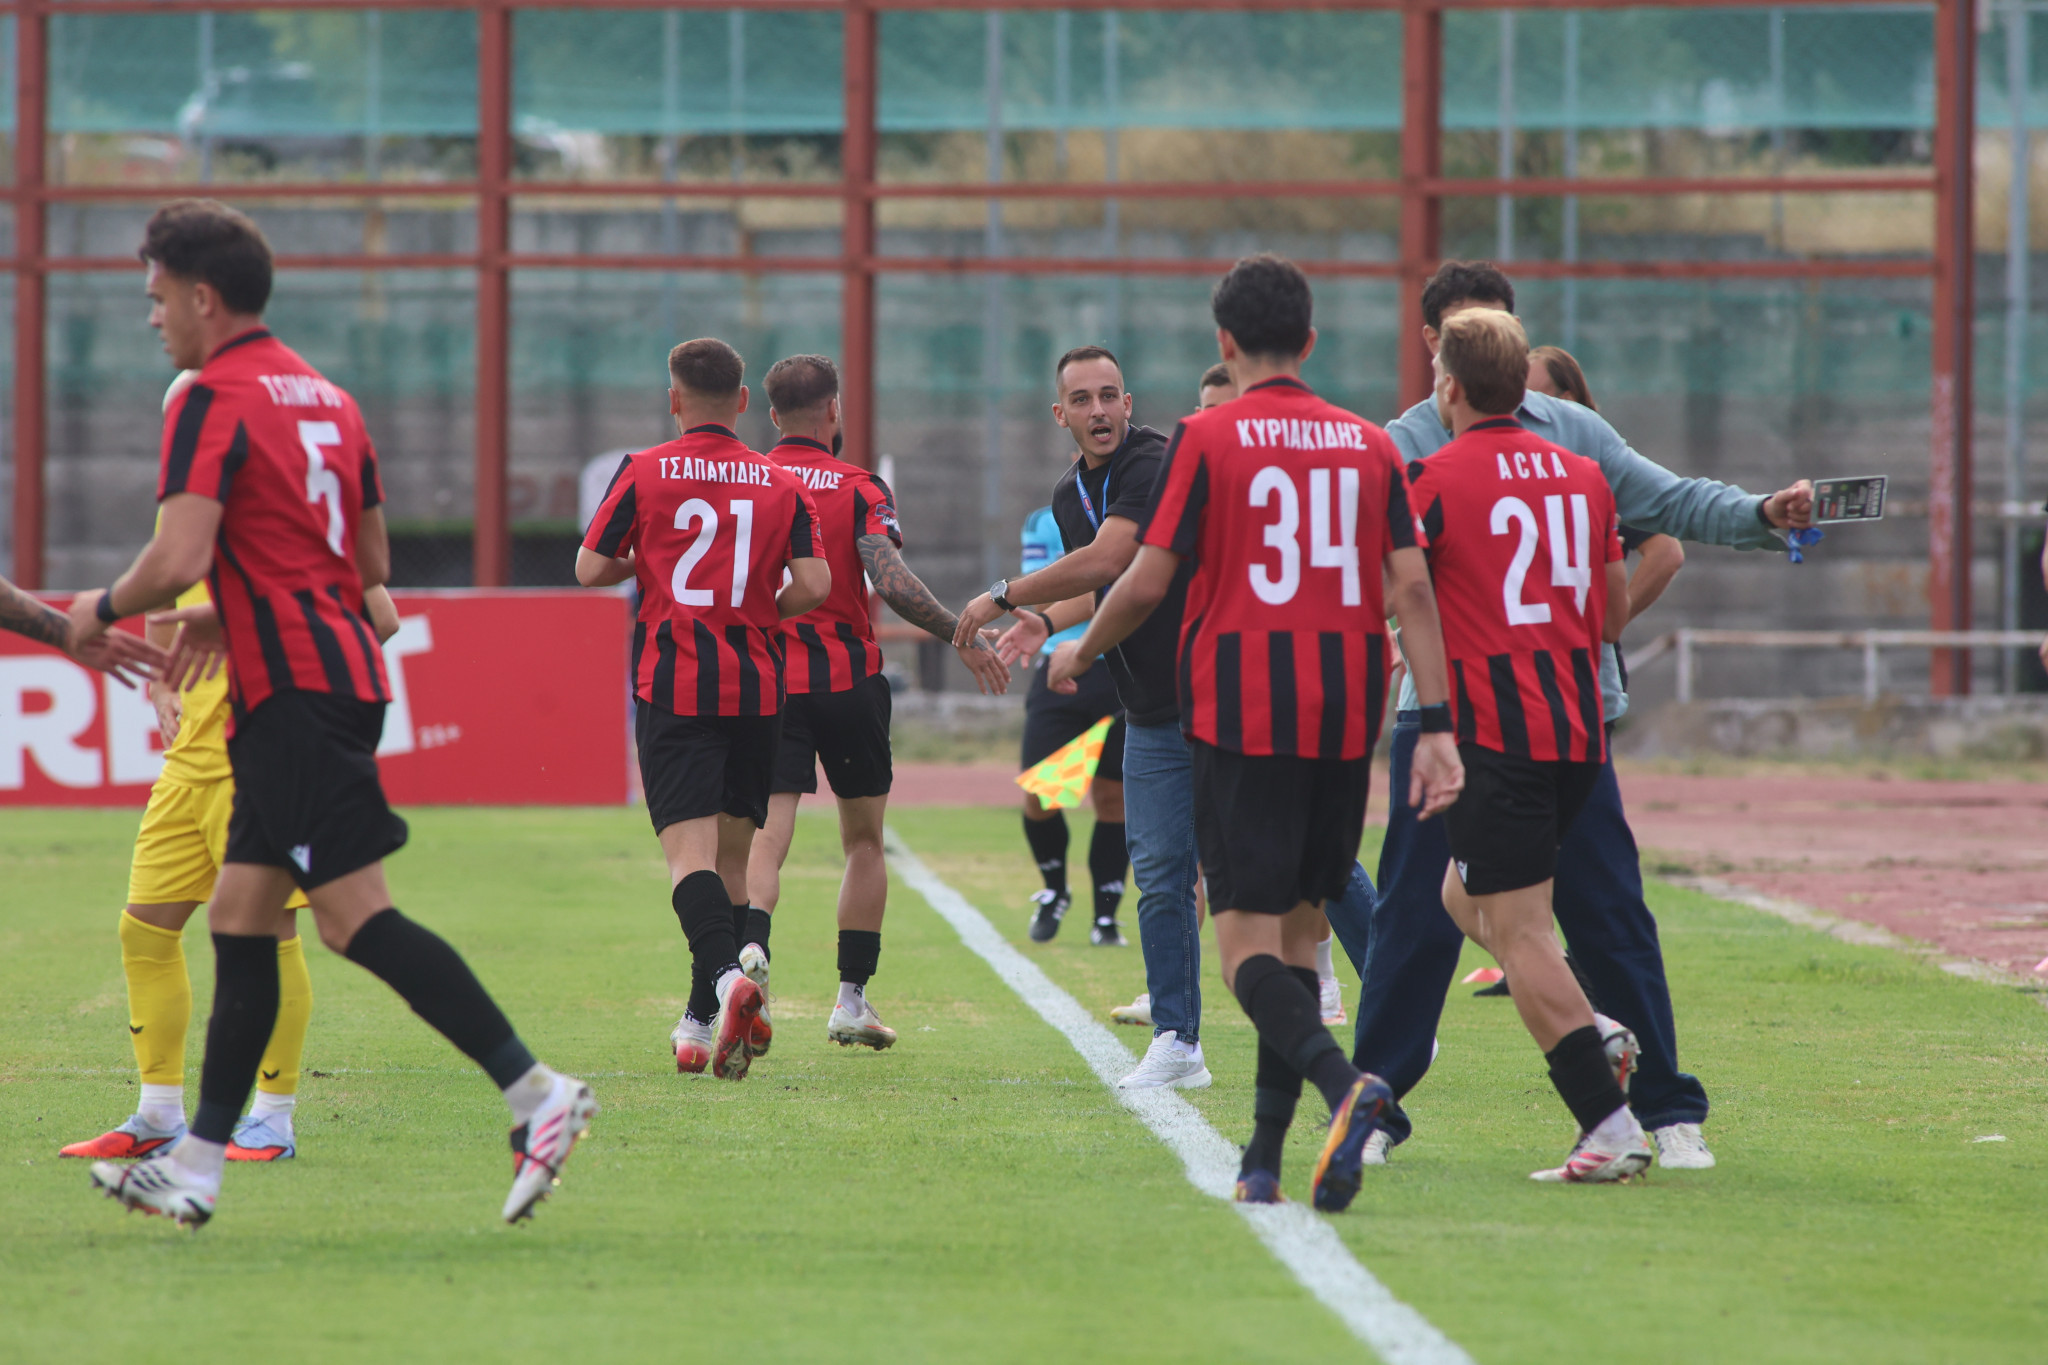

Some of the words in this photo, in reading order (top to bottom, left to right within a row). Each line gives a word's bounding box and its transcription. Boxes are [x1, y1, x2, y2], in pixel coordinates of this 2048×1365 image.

[297, 420, 346, 557] 5
[659, 456, 772, 487] ΤΣΑΠΑΚΙΔΗΣ
[1236, 418, 1368, 450] ΚΥΡΙΑΚΙΔΗΣ
[671, 498, 753, 608] 21
[1249, 465, 1361, 606] 34
[1489, 493, 1592, 626] 24
